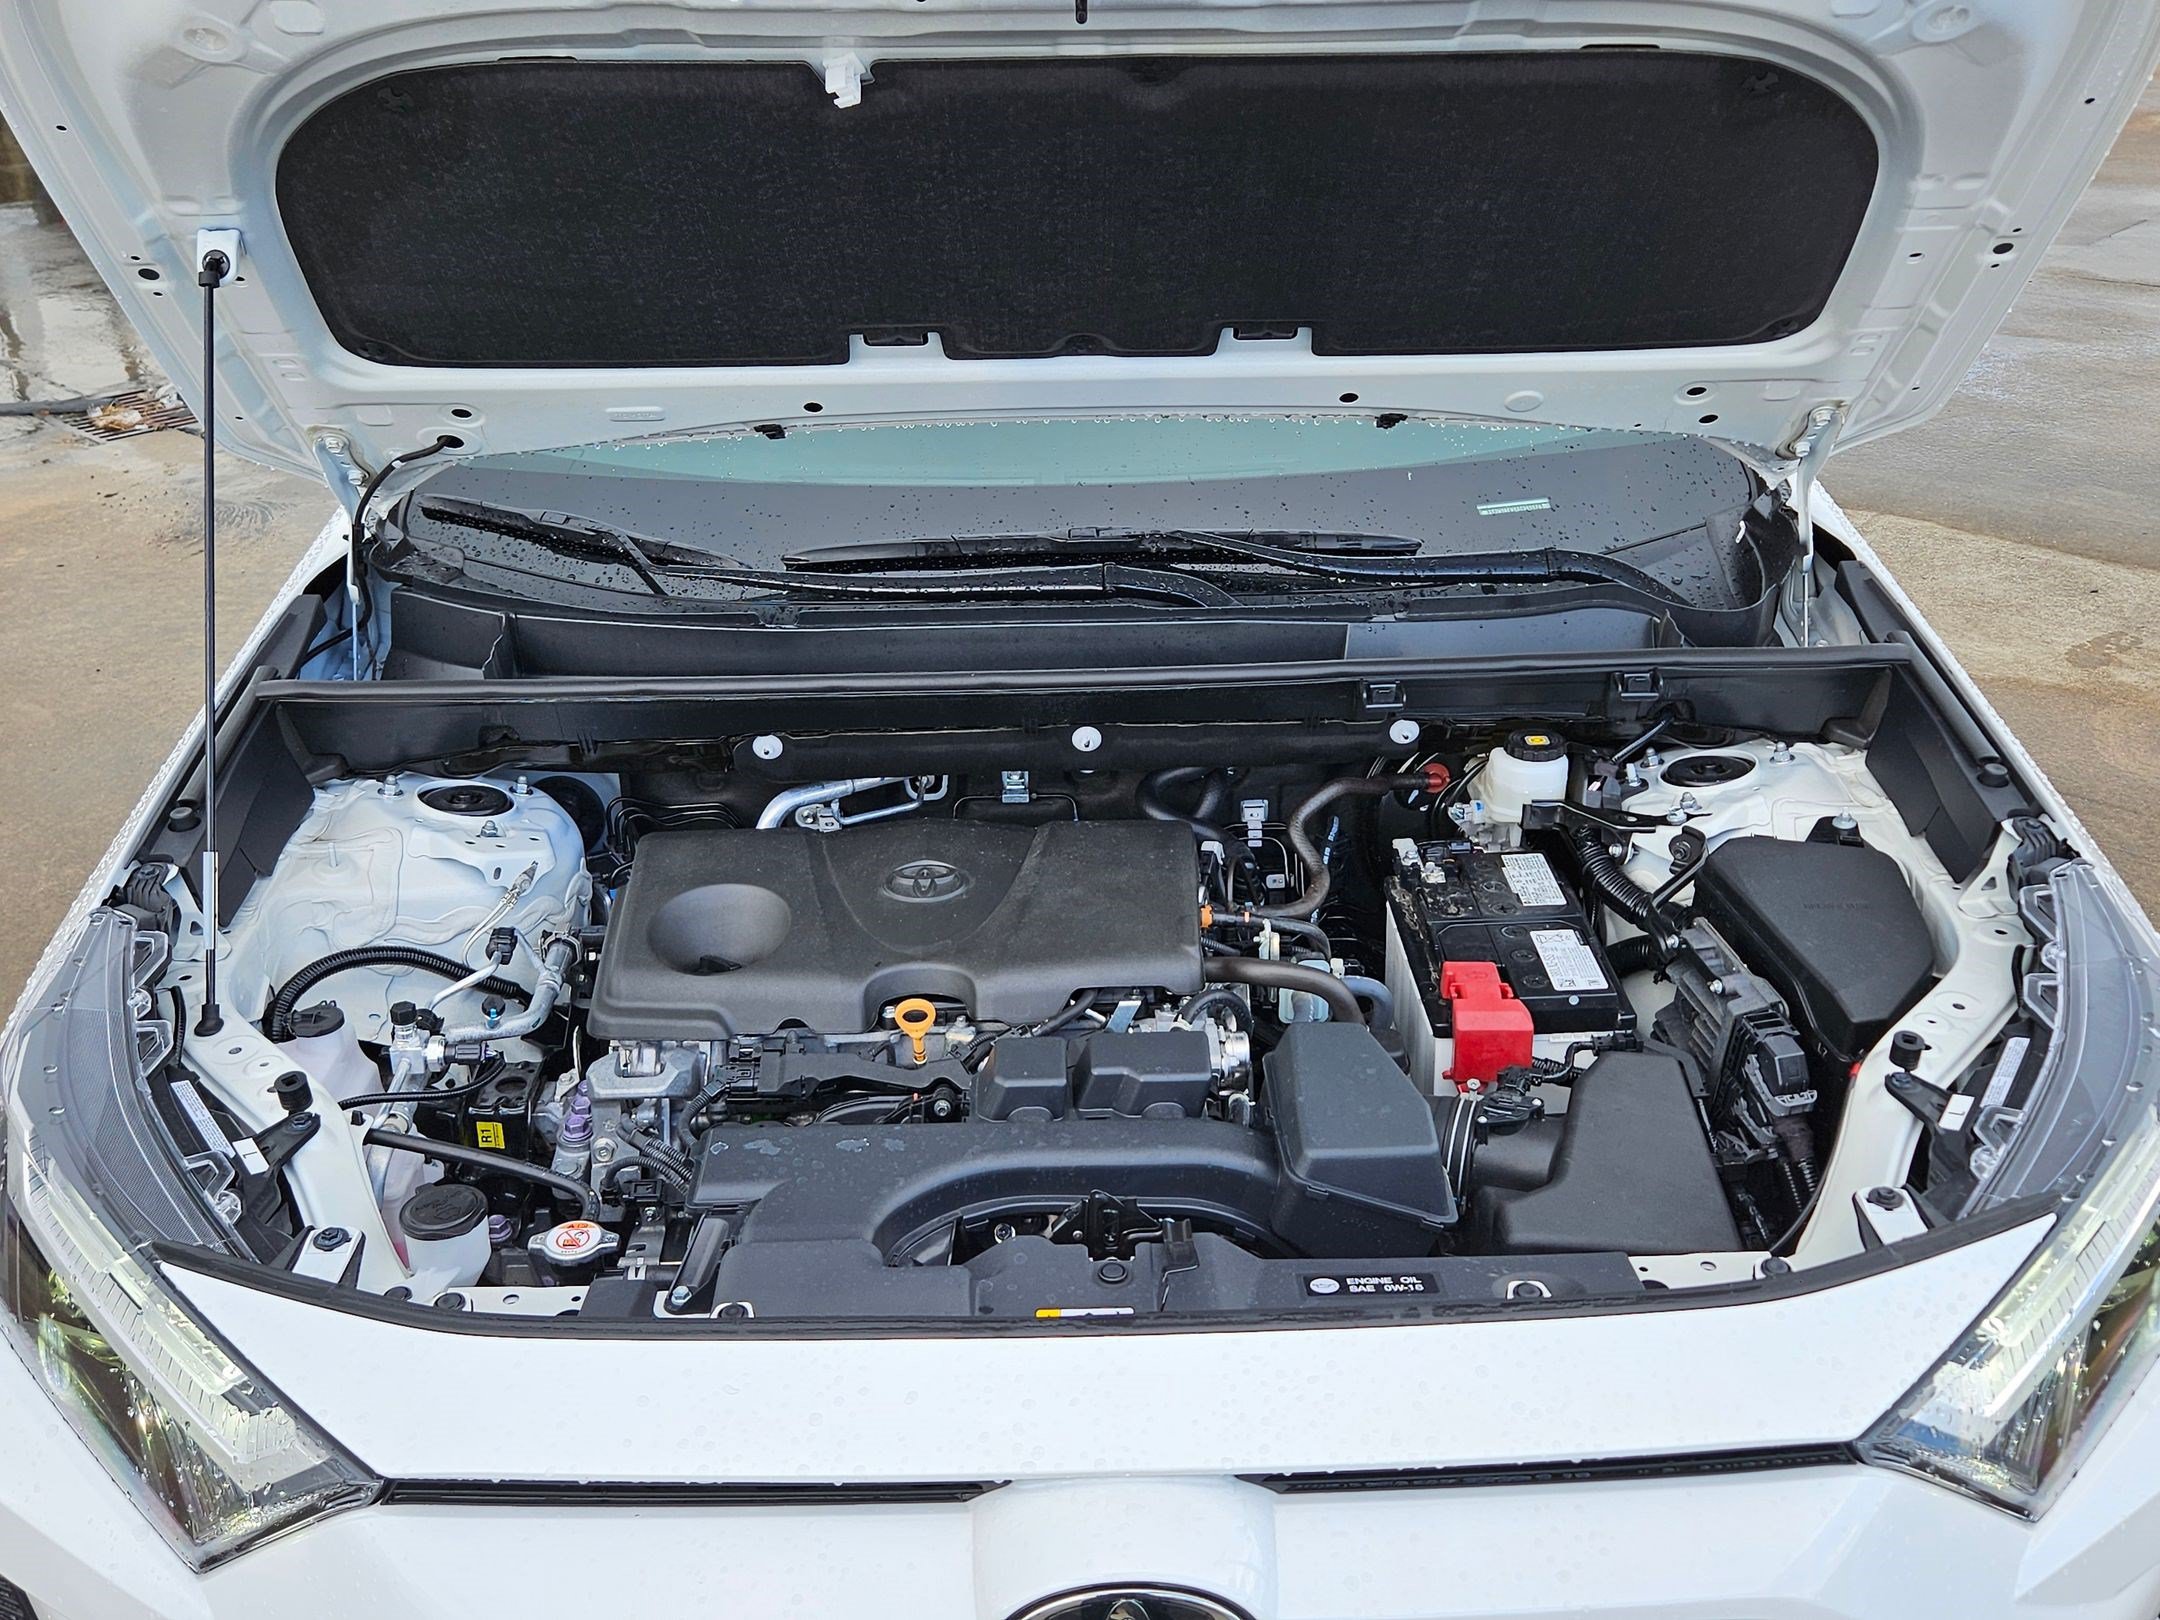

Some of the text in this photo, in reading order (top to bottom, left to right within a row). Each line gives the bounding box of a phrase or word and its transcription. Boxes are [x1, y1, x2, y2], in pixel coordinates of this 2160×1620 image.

[481, 1129, 492, 1143] R1
[1345, 1276, 1422, 1285] ENGINE OIL
[1348, 1284, 1376, 1293] SAE
